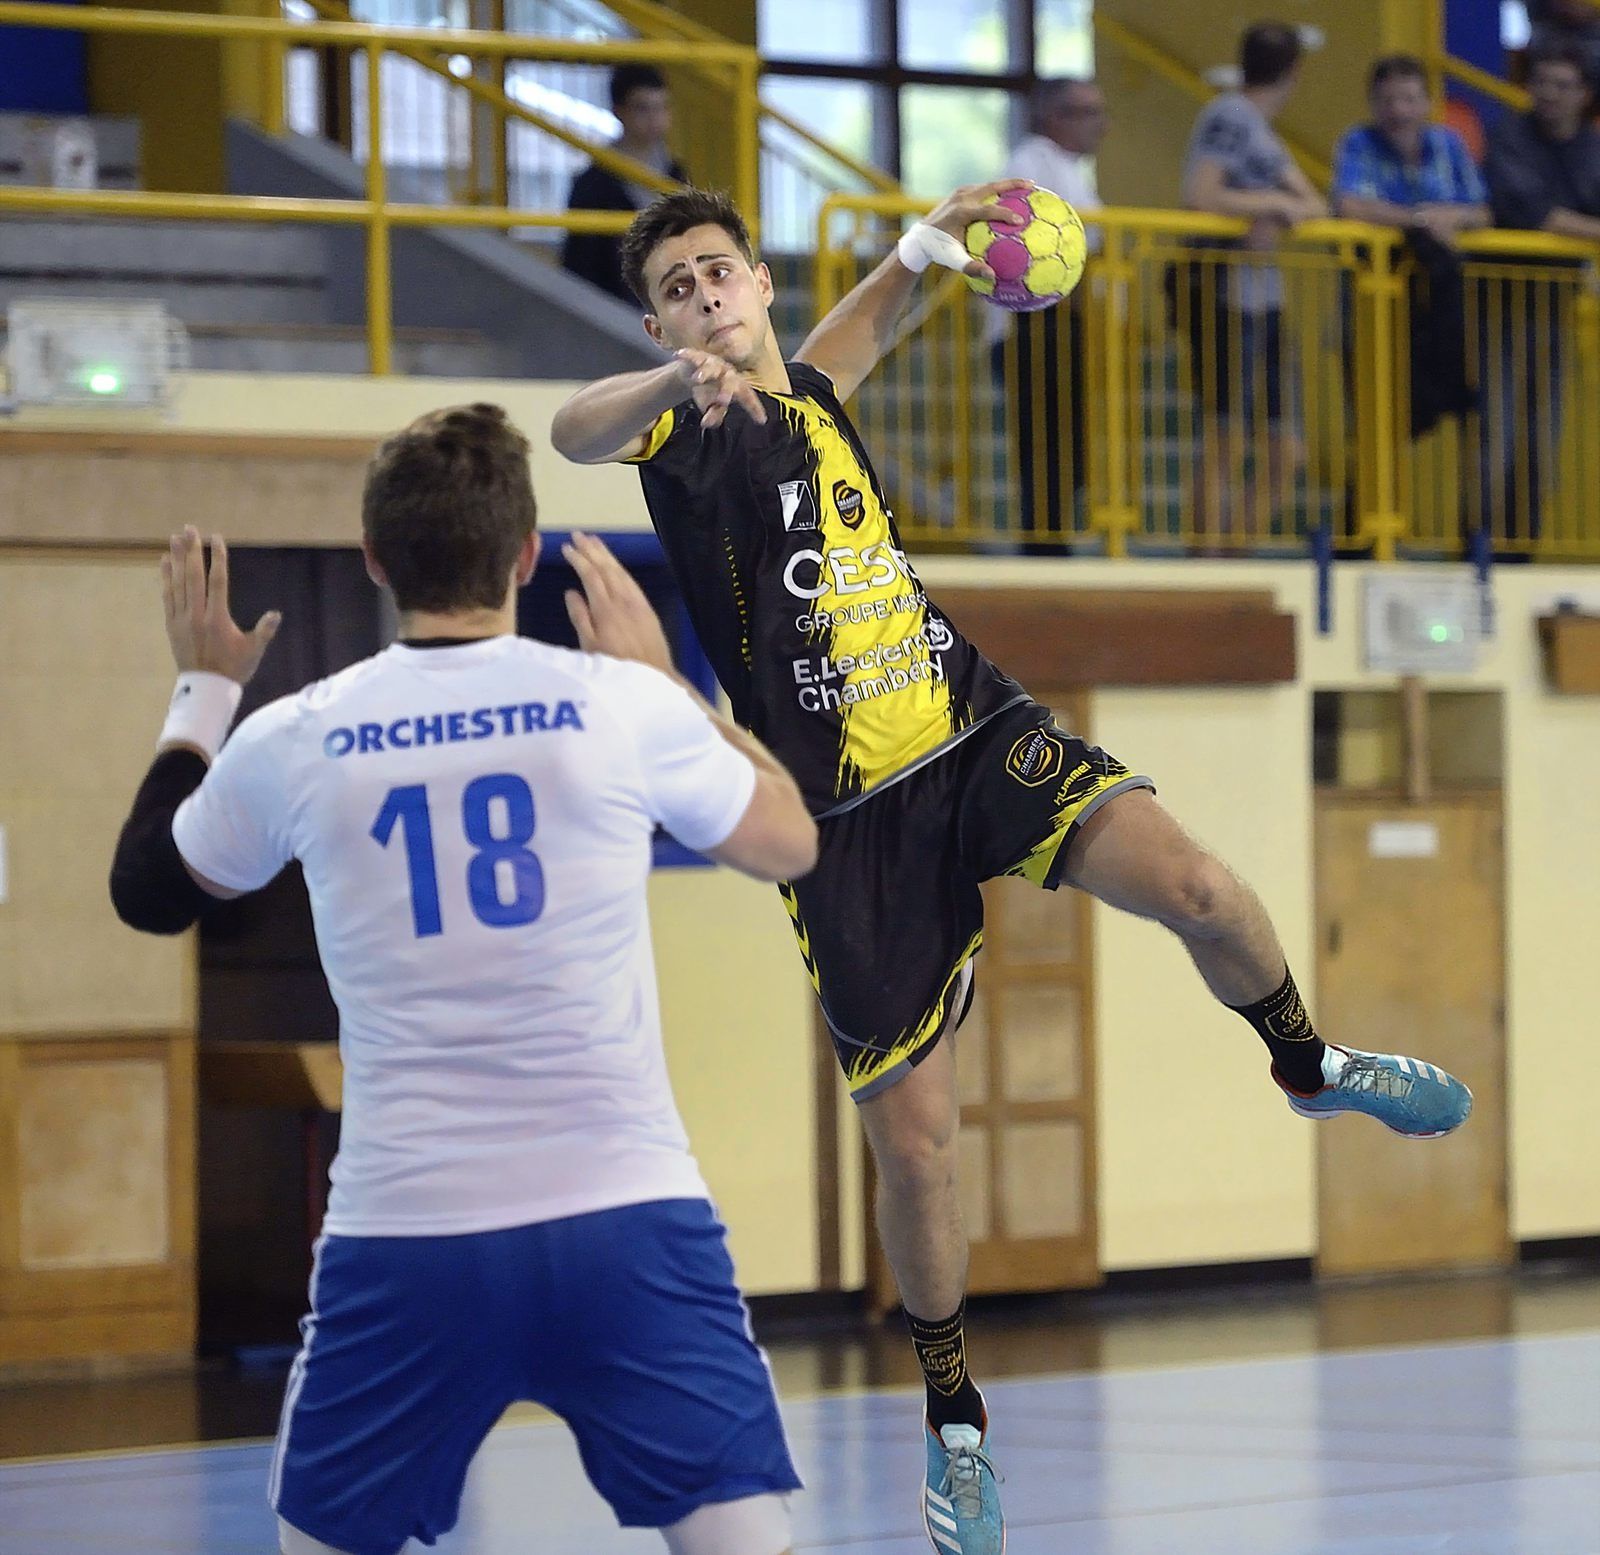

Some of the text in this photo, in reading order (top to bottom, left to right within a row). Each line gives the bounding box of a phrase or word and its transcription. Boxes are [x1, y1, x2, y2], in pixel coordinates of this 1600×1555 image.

[795, 597, 892, 633] GROUPE
[798, 652, 944, 712] Chambéry
[323, 699, 585, 759] ORCHESTRA
[369, 772, 546, 939] 18
